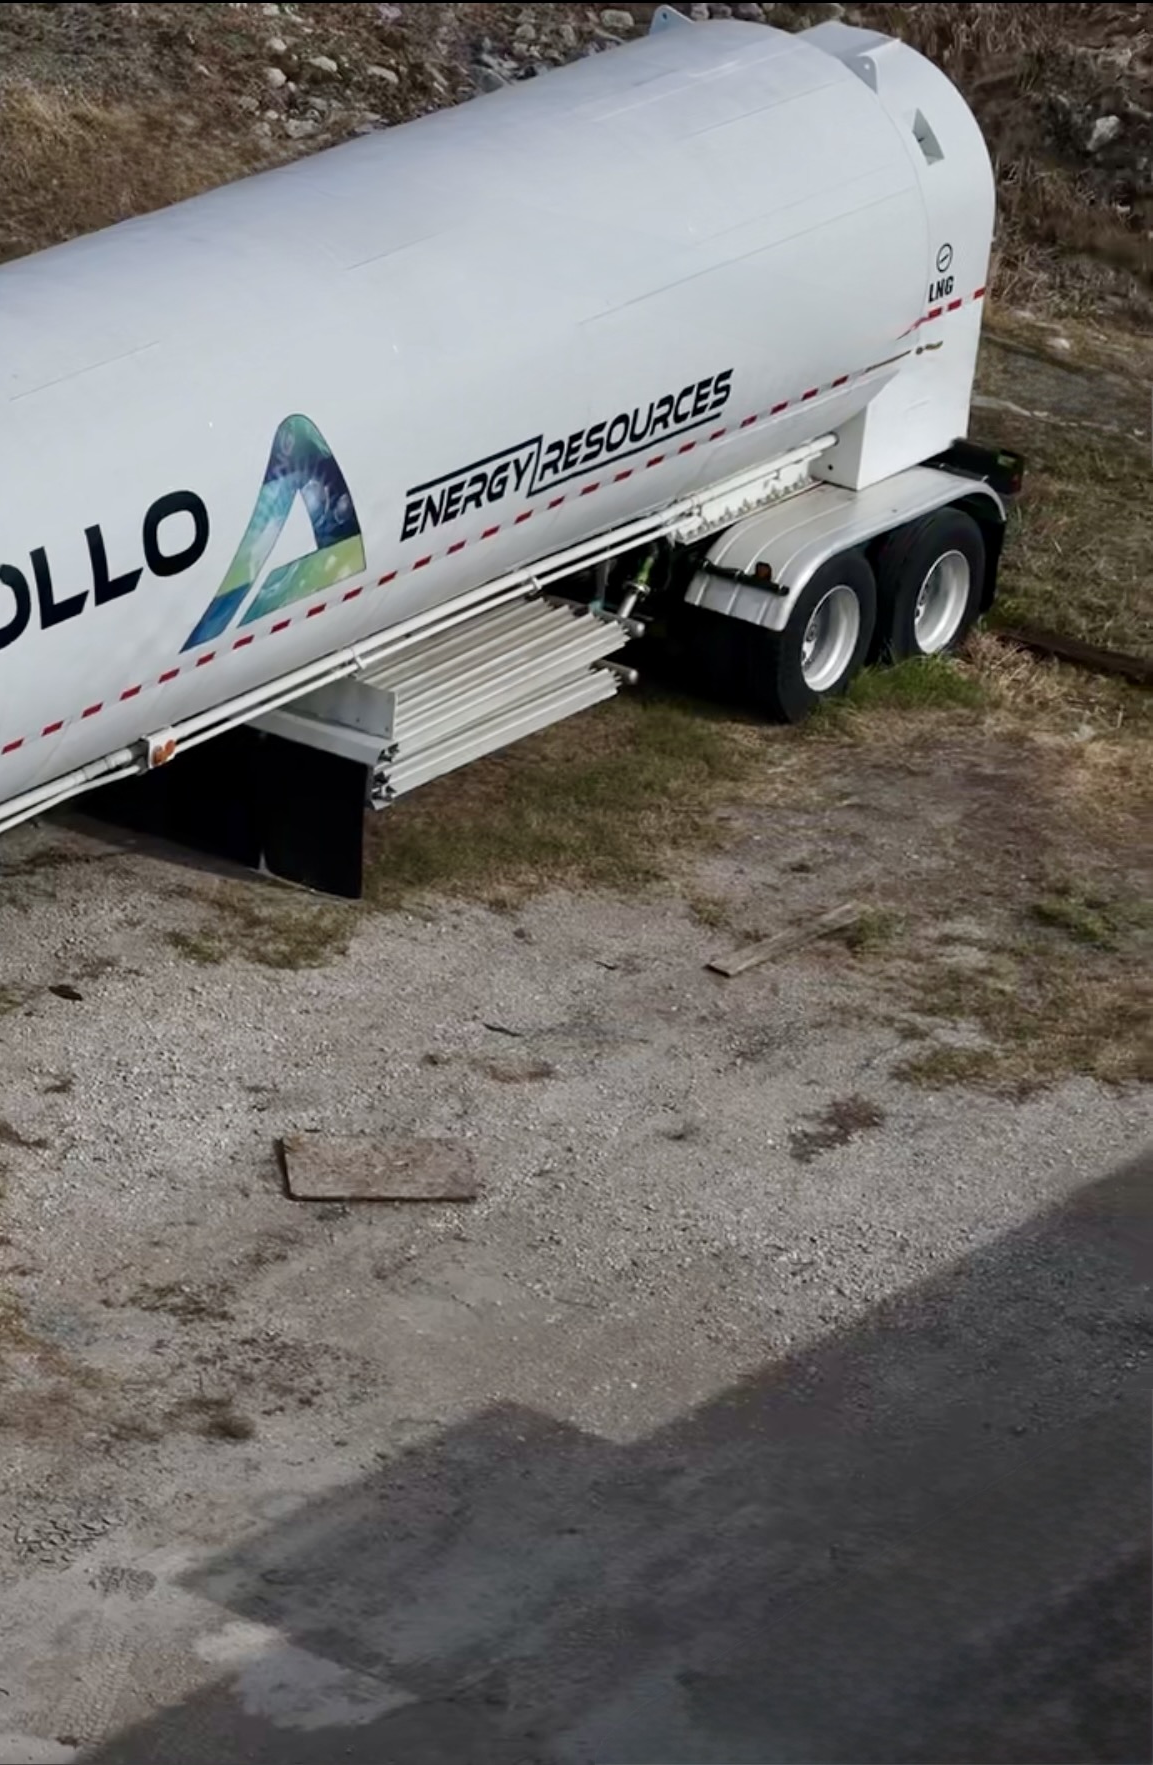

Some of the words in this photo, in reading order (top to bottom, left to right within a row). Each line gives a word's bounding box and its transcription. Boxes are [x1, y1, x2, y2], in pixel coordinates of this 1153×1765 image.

[928, 275, 954, 303] LNG
[400, 452, 534, 542] ENERGY
[538, 368, 734, 482] RESOURCES
